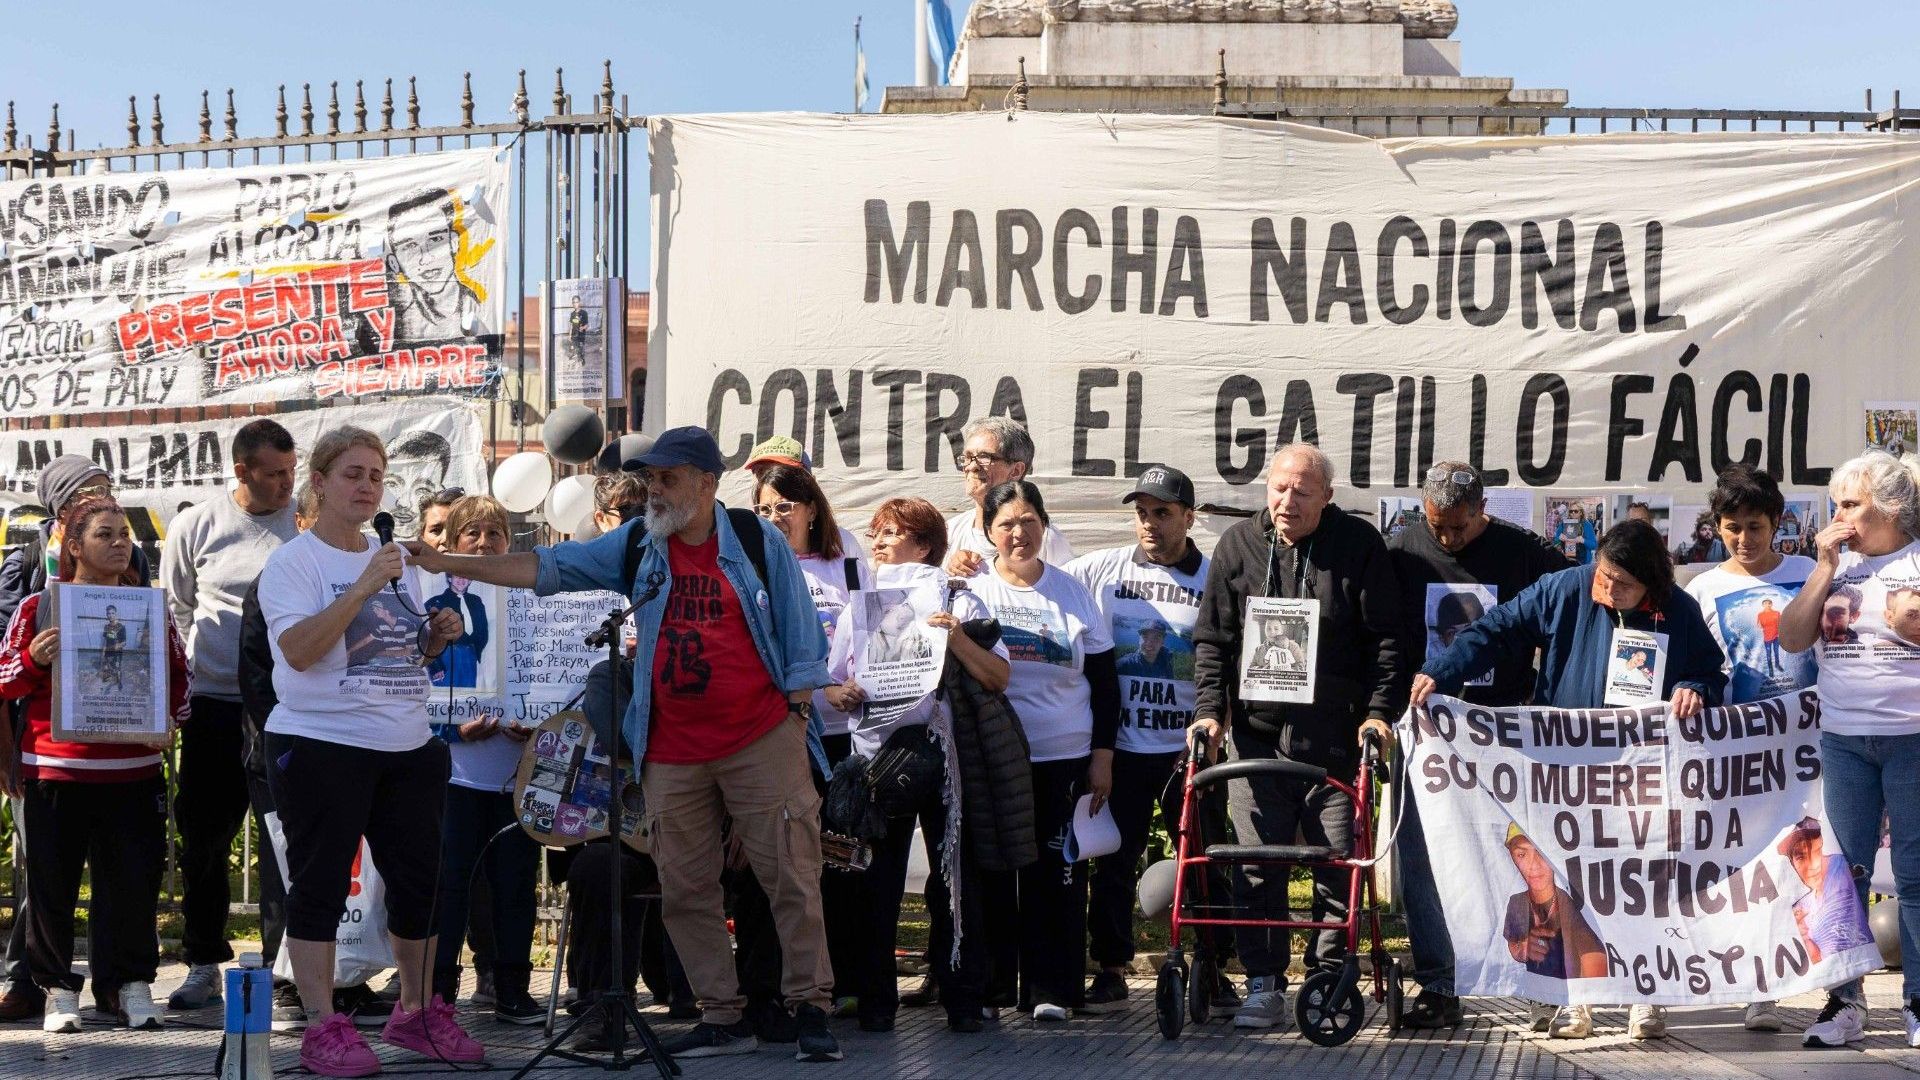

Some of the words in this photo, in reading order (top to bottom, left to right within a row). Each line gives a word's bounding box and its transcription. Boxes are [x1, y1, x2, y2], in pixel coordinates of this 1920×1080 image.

[235, 171, 357, 223] PABLO
[208, 218, 362, 267] ALCORTA
[863, 199, 1208, 318] MARCHA
[1250, 214, 1687, 334] NACIONAL
[115, 258, 389, 365] PRESENTE
[213, 315, 352, 388] AHORA
[363, 306, 396, 352] Y
[314, 344, 490, 398] SIEMPRE
[52, 369, 95, 407] DE
[103, 364, 179, 407] PALY
[706, 368, 1033, 474] CONTRA
[1072, 368, 1167, 478] EL
[1215, 372, 1570, 486] GATILLO
[1605, 342, 1833, 487] FÁCIL
[91, 429, 225, 489] ALMA
[669, 595, 724, 622] ABLO
[671, 574, 722, 598] UERZA
[507, 609, 546, 624] Rafael
[427, 698, 465, 716] arcelo
[1129, 679, 1177, 706] PARA
[1411, 701, 1457, 745] NO
[1466, 708, 1523, 749] SE
[1531, 706, 1669, 748] MUERE
[1678, 698, 1788, 744] QUIEN
[1797, 690, 1821, 731] S
[1531, 762, 1662, 807] MUERE
[1680, 748, 1787, 801] QUIEN
[1795, 744, 1822, 782] S
[1553, 807, 1744, 850] OLVIDA
[1565, 856, 1779, 918] JUSTICIA
[1604, 937, 1810, 995] AGUSTIN
